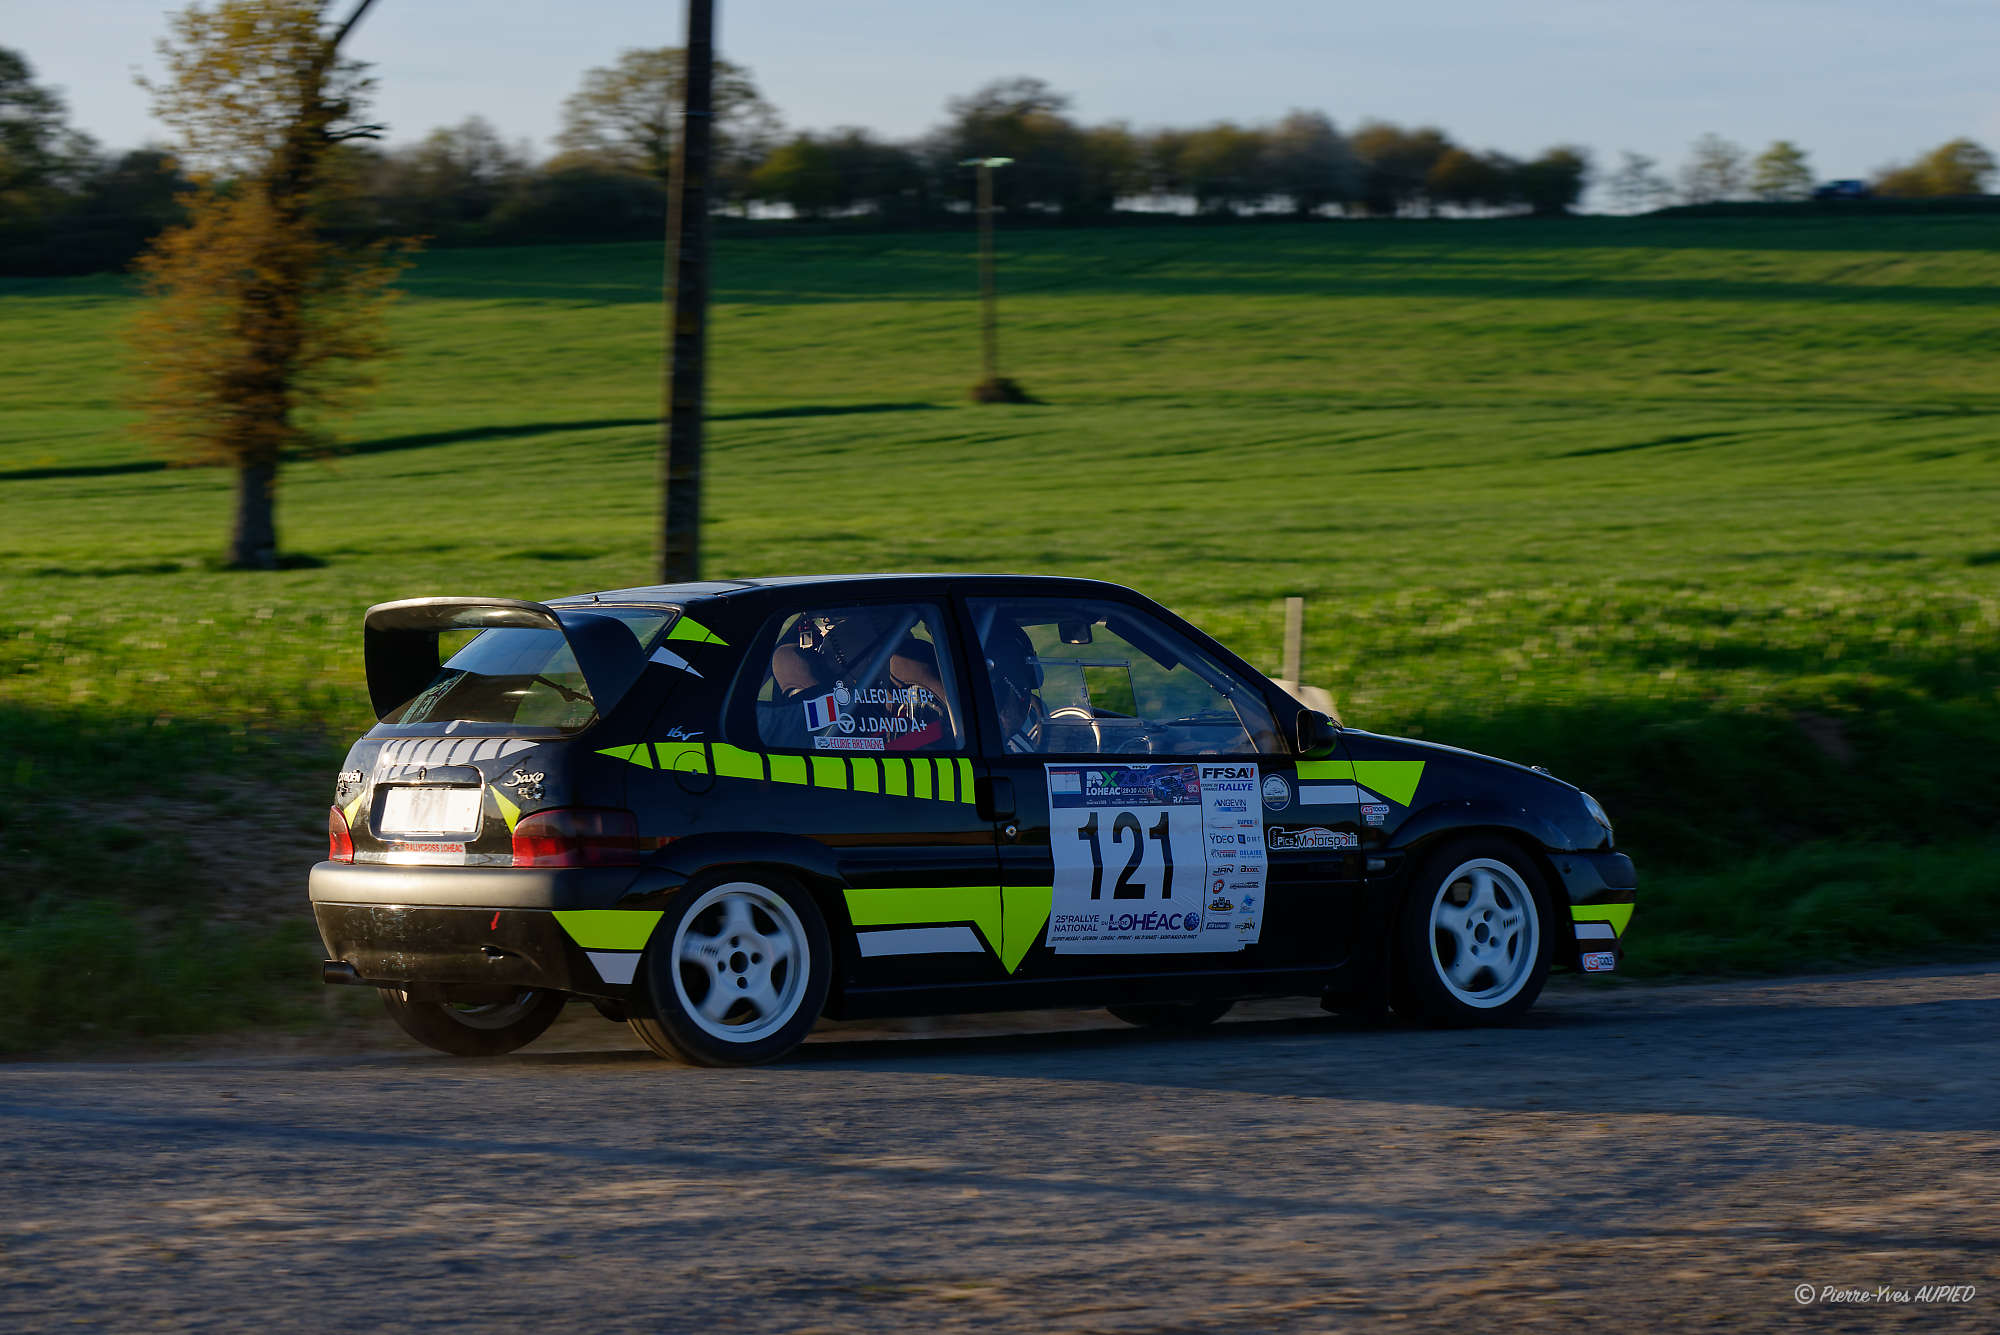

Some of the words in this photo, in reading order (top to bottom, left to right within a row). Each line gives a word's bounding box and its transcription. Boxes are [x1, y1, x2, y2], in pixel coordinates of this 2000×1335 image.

[854, 688, 917, 704] A.LECLAIRE
[920, 688, 935, 705] B+
[858, 717, 908, 733] J.DAVID
[911, 717, 928, 733] A+
[504, 768, 545, 787] Saxo
[1086, 770, 1118, 787] RX
[1086, 787, 1121, 796] LOHEAC
[1218, 783, 1254, 792] RALLYE
[1077, 811, 1173, 900] 121
[1068, 914, 1100, 923] RALLYE
[1107, 910, 1183, 931] LOHÉAC
[1054, 923, 1099, 932] NATIONAL
